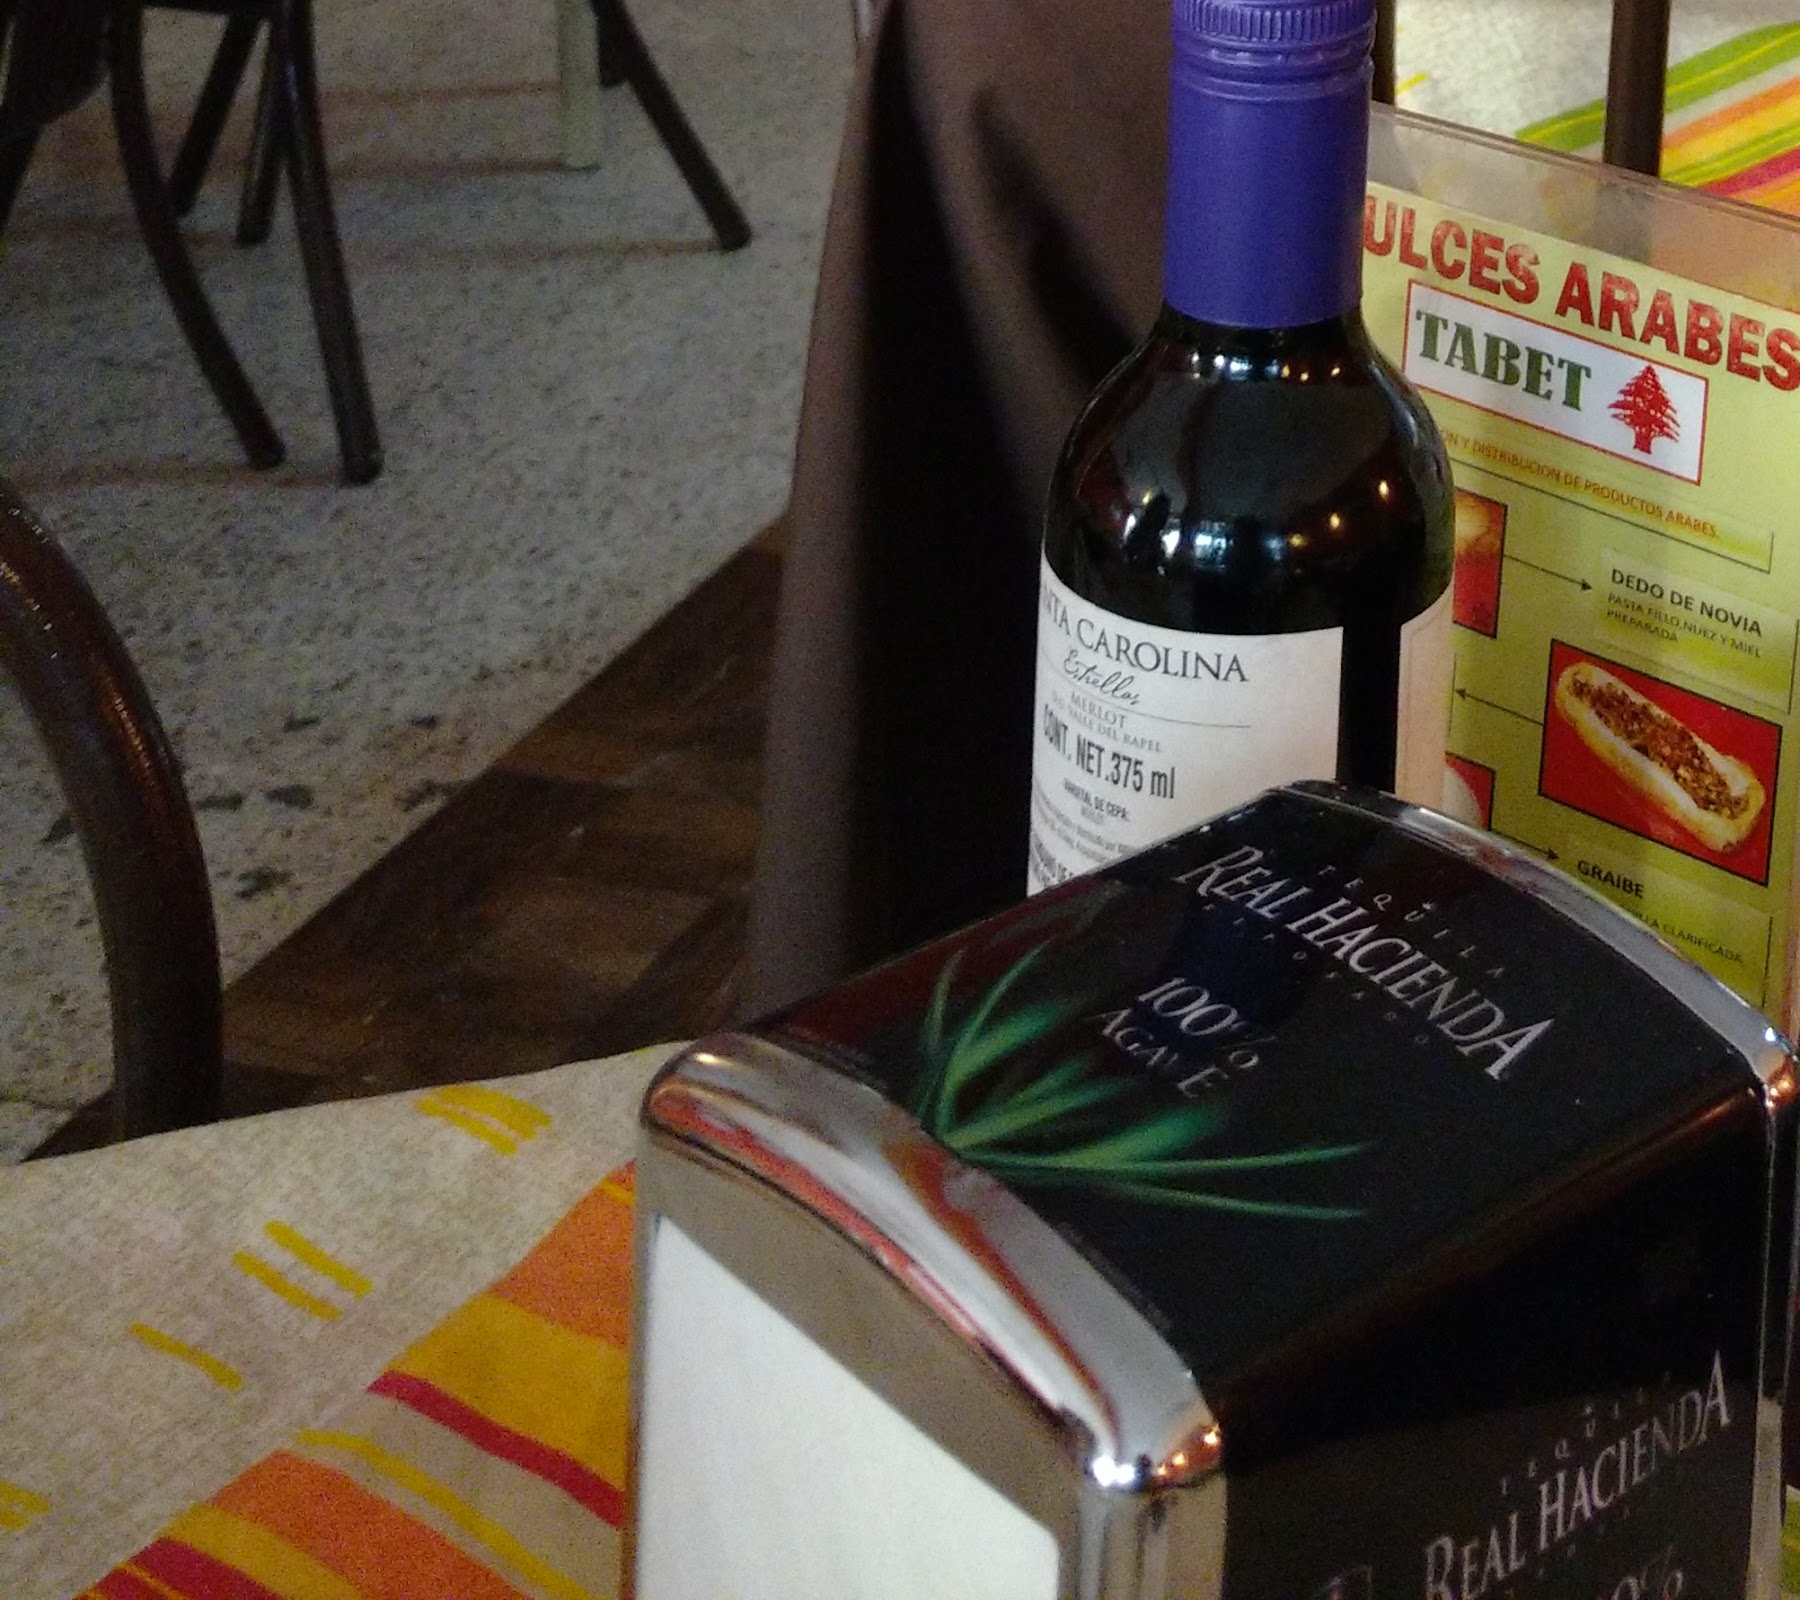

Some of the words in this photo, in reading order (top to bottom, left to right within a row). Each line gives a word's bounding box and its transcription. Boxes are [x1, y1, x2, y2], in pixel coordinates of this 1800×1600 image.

[1363, 194, 1541, 305] ULCES
[1415, 308, 1592, 413] TABET
[1583, 479, 1664, 522] PRODUCTOS
[1610, 566, 1665, 601] DEDO
[1669, 588, 1694, 611] DE
[1699, 599, 1763, 638] NOVIA
[1076, 618, 1250, 683] CAROLINA
[1043, 703, 1073, 762] CONT.
[1149, 765, 1177, 800] ml
[1070, 692, 1128, 728] MERLOT
[1577, 859, 1645, 899] GRAIBE
[1171, 844, 1312, 920] REAL
[1286, 897, 1556, 1081] HACIENDA
[1424, 1511, 1528, 1600] REAL
[1537, 1348, 1732, 1554] HACIENDA
